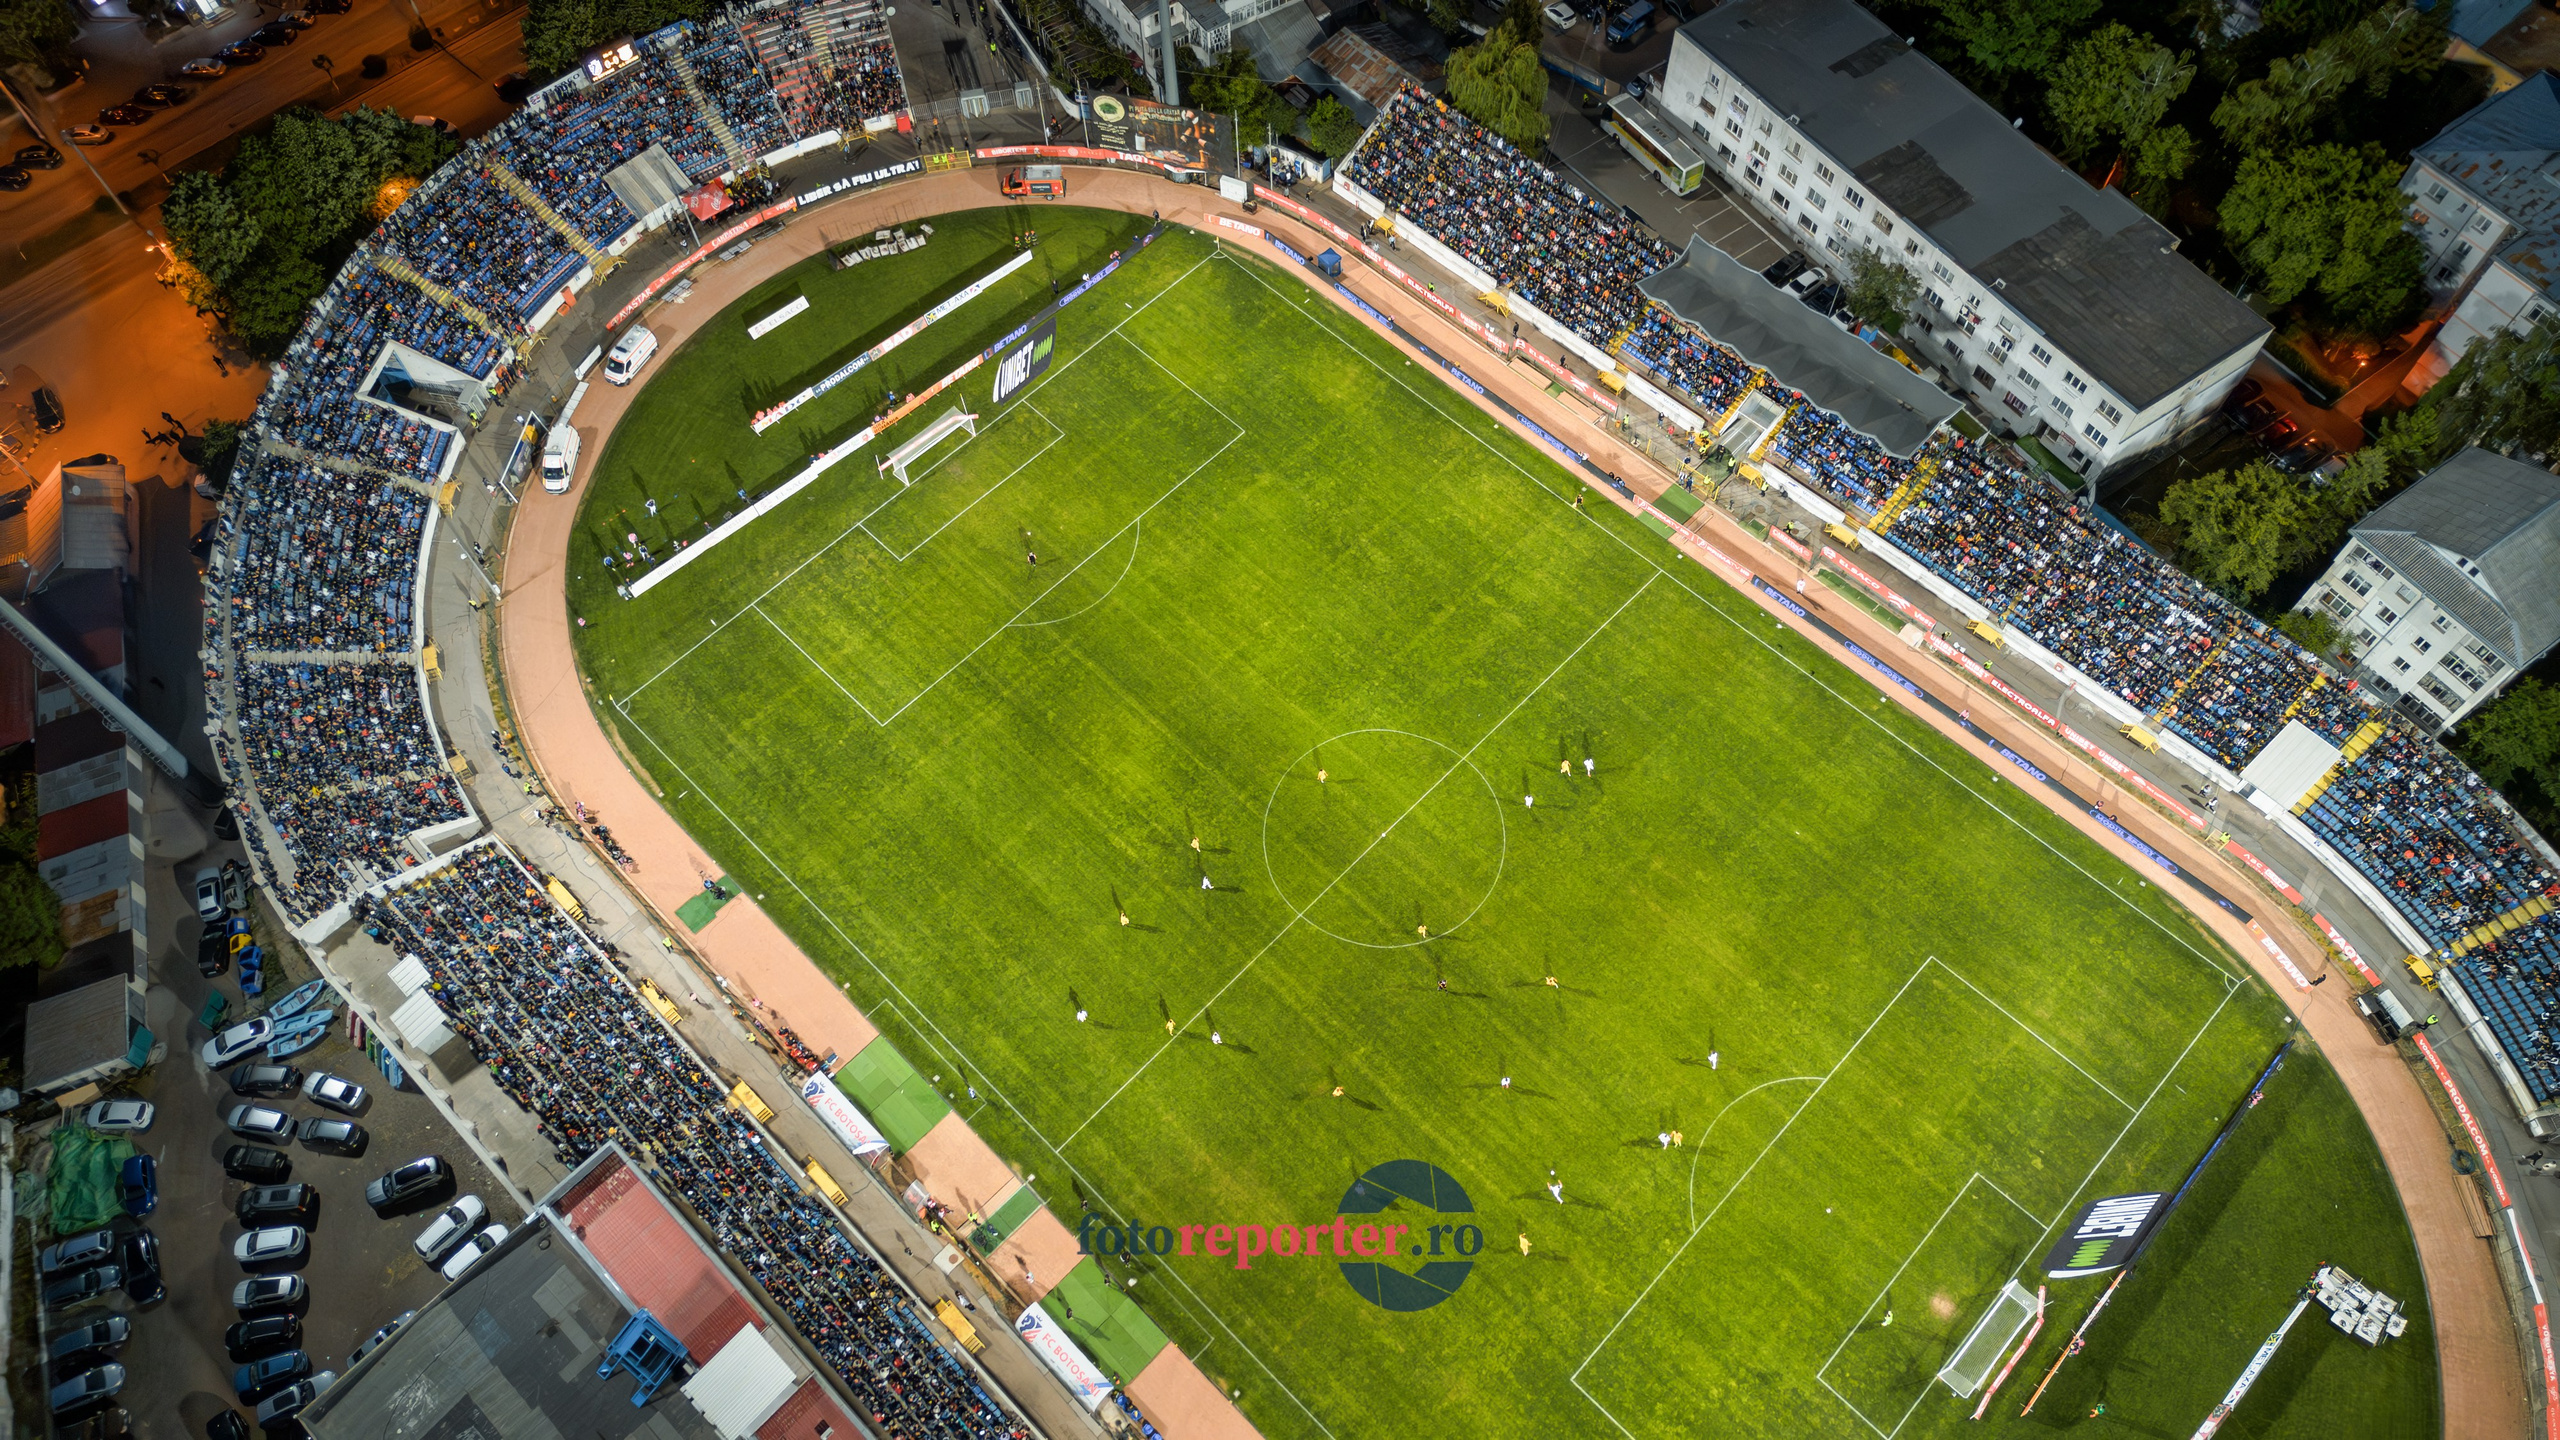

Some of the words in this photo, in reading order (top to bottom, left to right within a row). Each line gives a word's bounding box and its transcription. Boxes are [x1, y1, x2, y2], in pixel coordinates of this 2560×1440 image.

[797, 186, 833, 206] LIBER
[852, 172, 873, 187] FIU
[1219, 217, 1261, 236] BETANO
[1274, 239, 1305, 266] BETANO
[618, 287, 653, 322] AVASTAR
[936, 290, 970, 314] MET-AXA
[1407, 277, 1455, 314] ELECTROALFA
[768, 303, 803, 327] ELSACO
[1460, 313, 1482, 331] UNIBET
[882, 326, 914, 351] BAD
[993, 324, 1028, 353] BETANO
[820, 359, 865, 391] PRODALCOM
[941, 357, 980, 389] BETANO
[1000, 340, 1034, 399] UNIBET
[1528, 348, 1564, 375] ELSACO
[1450, 367, 1485, 395] BETANO
[1838, 560, 1881, 589] ELSACO
[1765, 586, 1806, 617] BETANO
[1849, 645, 1876, 666] MODUL
[1929, 634, 1958, 657] UNIBET
[1961, 655, 1990, 679] UNIBET
[1991, 678, 2056, 727] ELECTROALFA
[2000, 748, 2047, 782] BETANO
[2065, 726, 2096, 751] UNIBET
[2098, 750, 2130, 774] UNIBET
[2095, 813, 2125, 838] MODUL
[2127, 836, 2154, 858] SPORT
[2243, 853, 2263, 868] ABC
[2261, 937, 2309, 988] BETANO
[824, 1097, 838, 1111] FC
[2419, 1038, 2440, 1070] VORONA
[2444, 1079, 2488, 1156] PRODALCOM
[2489, 1167, 2506, 1201] VORONA
[2073, 1193, 2161, 1239] UNIBET
[1042, 1333, 1056, 1348] FC
